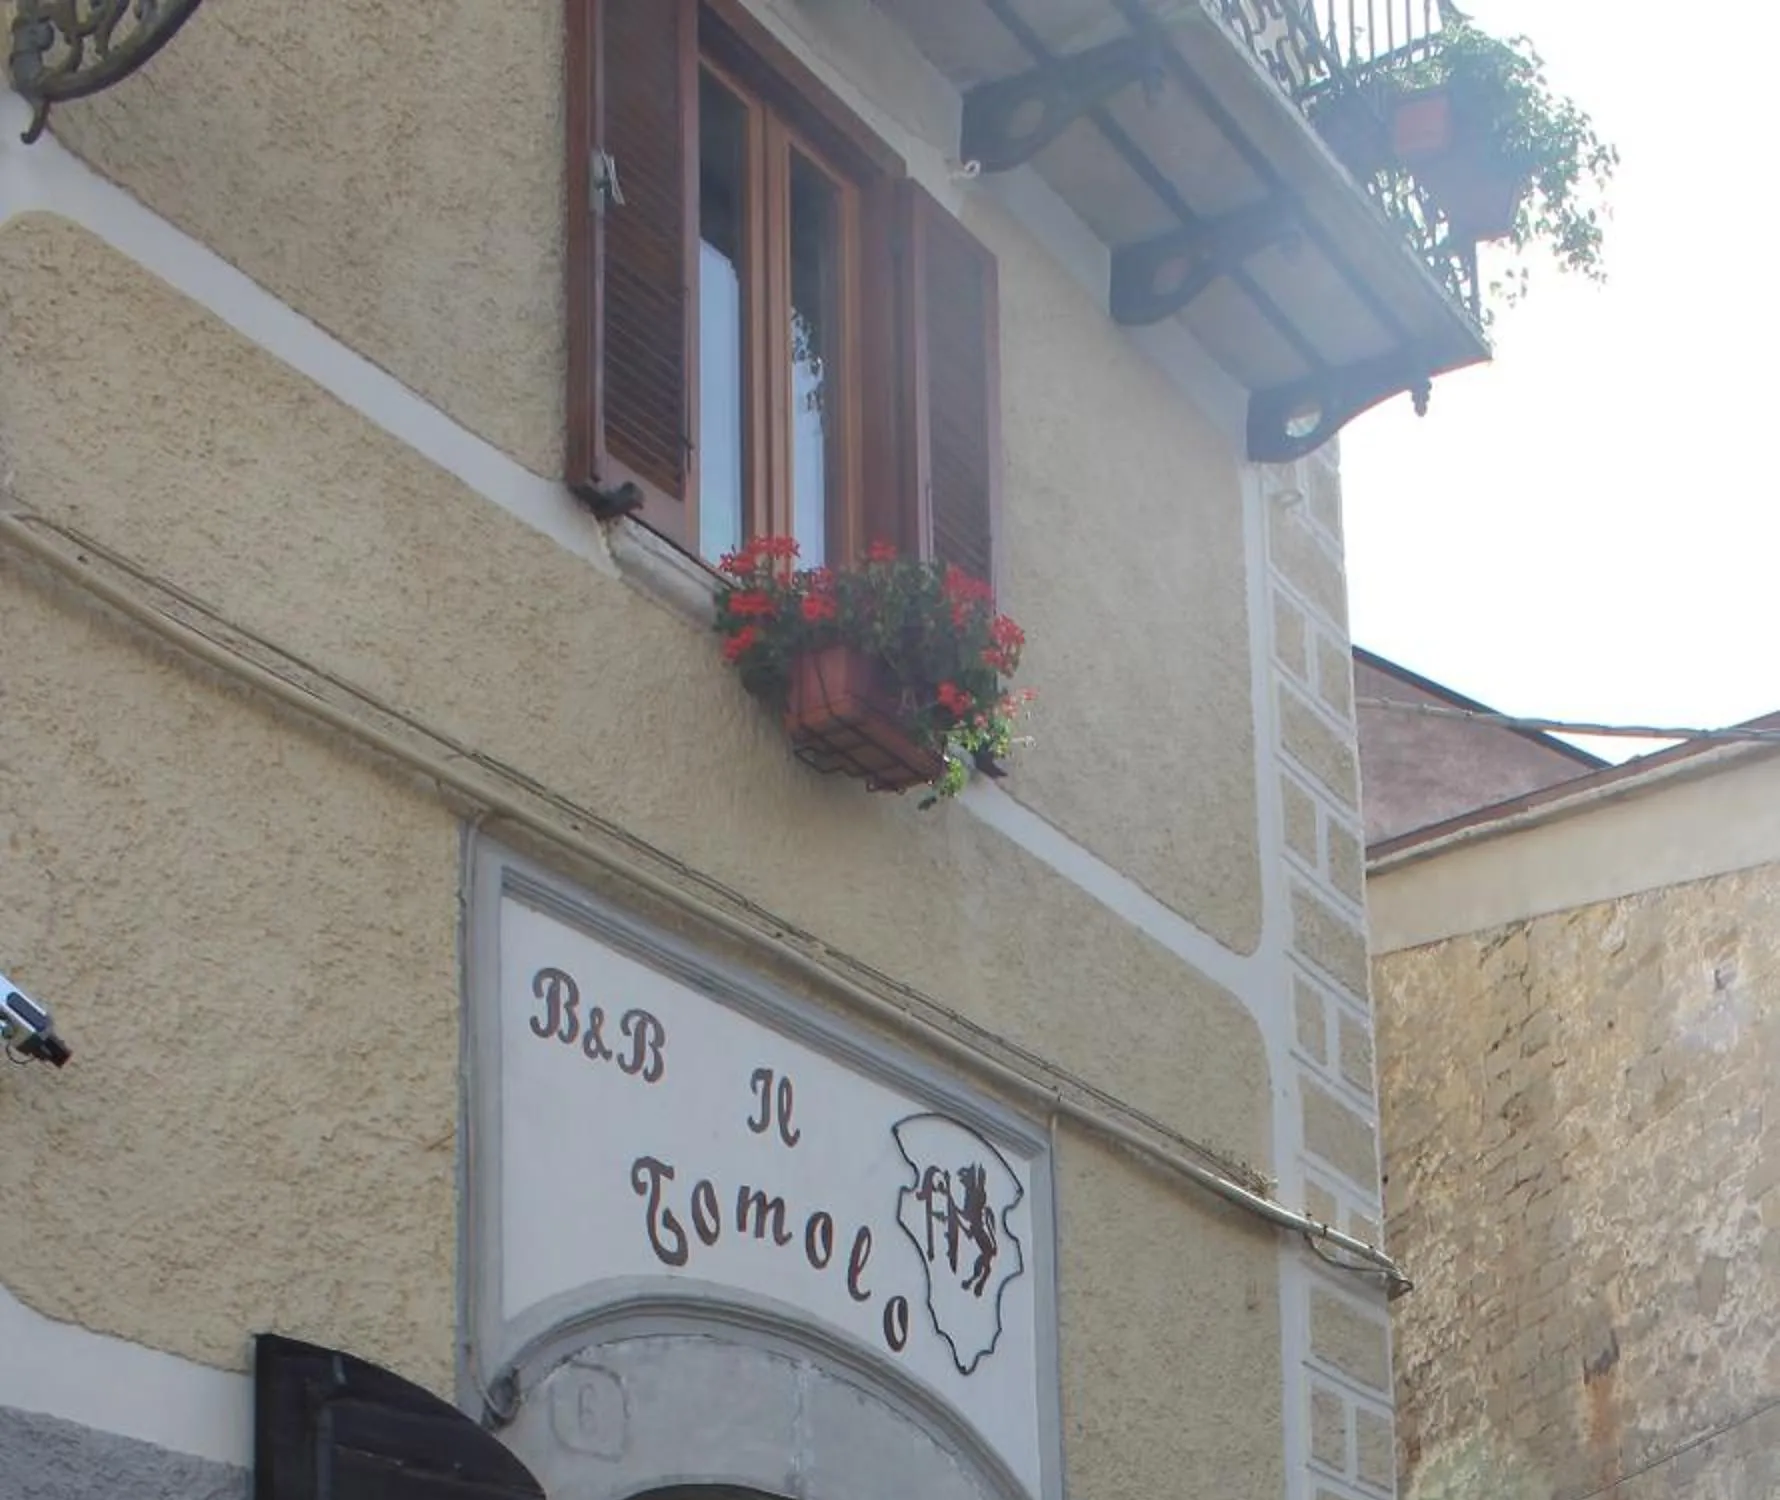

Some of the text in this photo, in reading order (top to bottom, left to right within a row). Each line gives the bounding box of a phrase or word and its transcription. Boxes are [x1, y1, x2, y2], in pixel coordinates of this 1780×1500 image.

[529, 966, 665, 1083] B&B
[746, 1067, 800, 1147] Il
[630, 1155, 908, 1352] Tomolo
